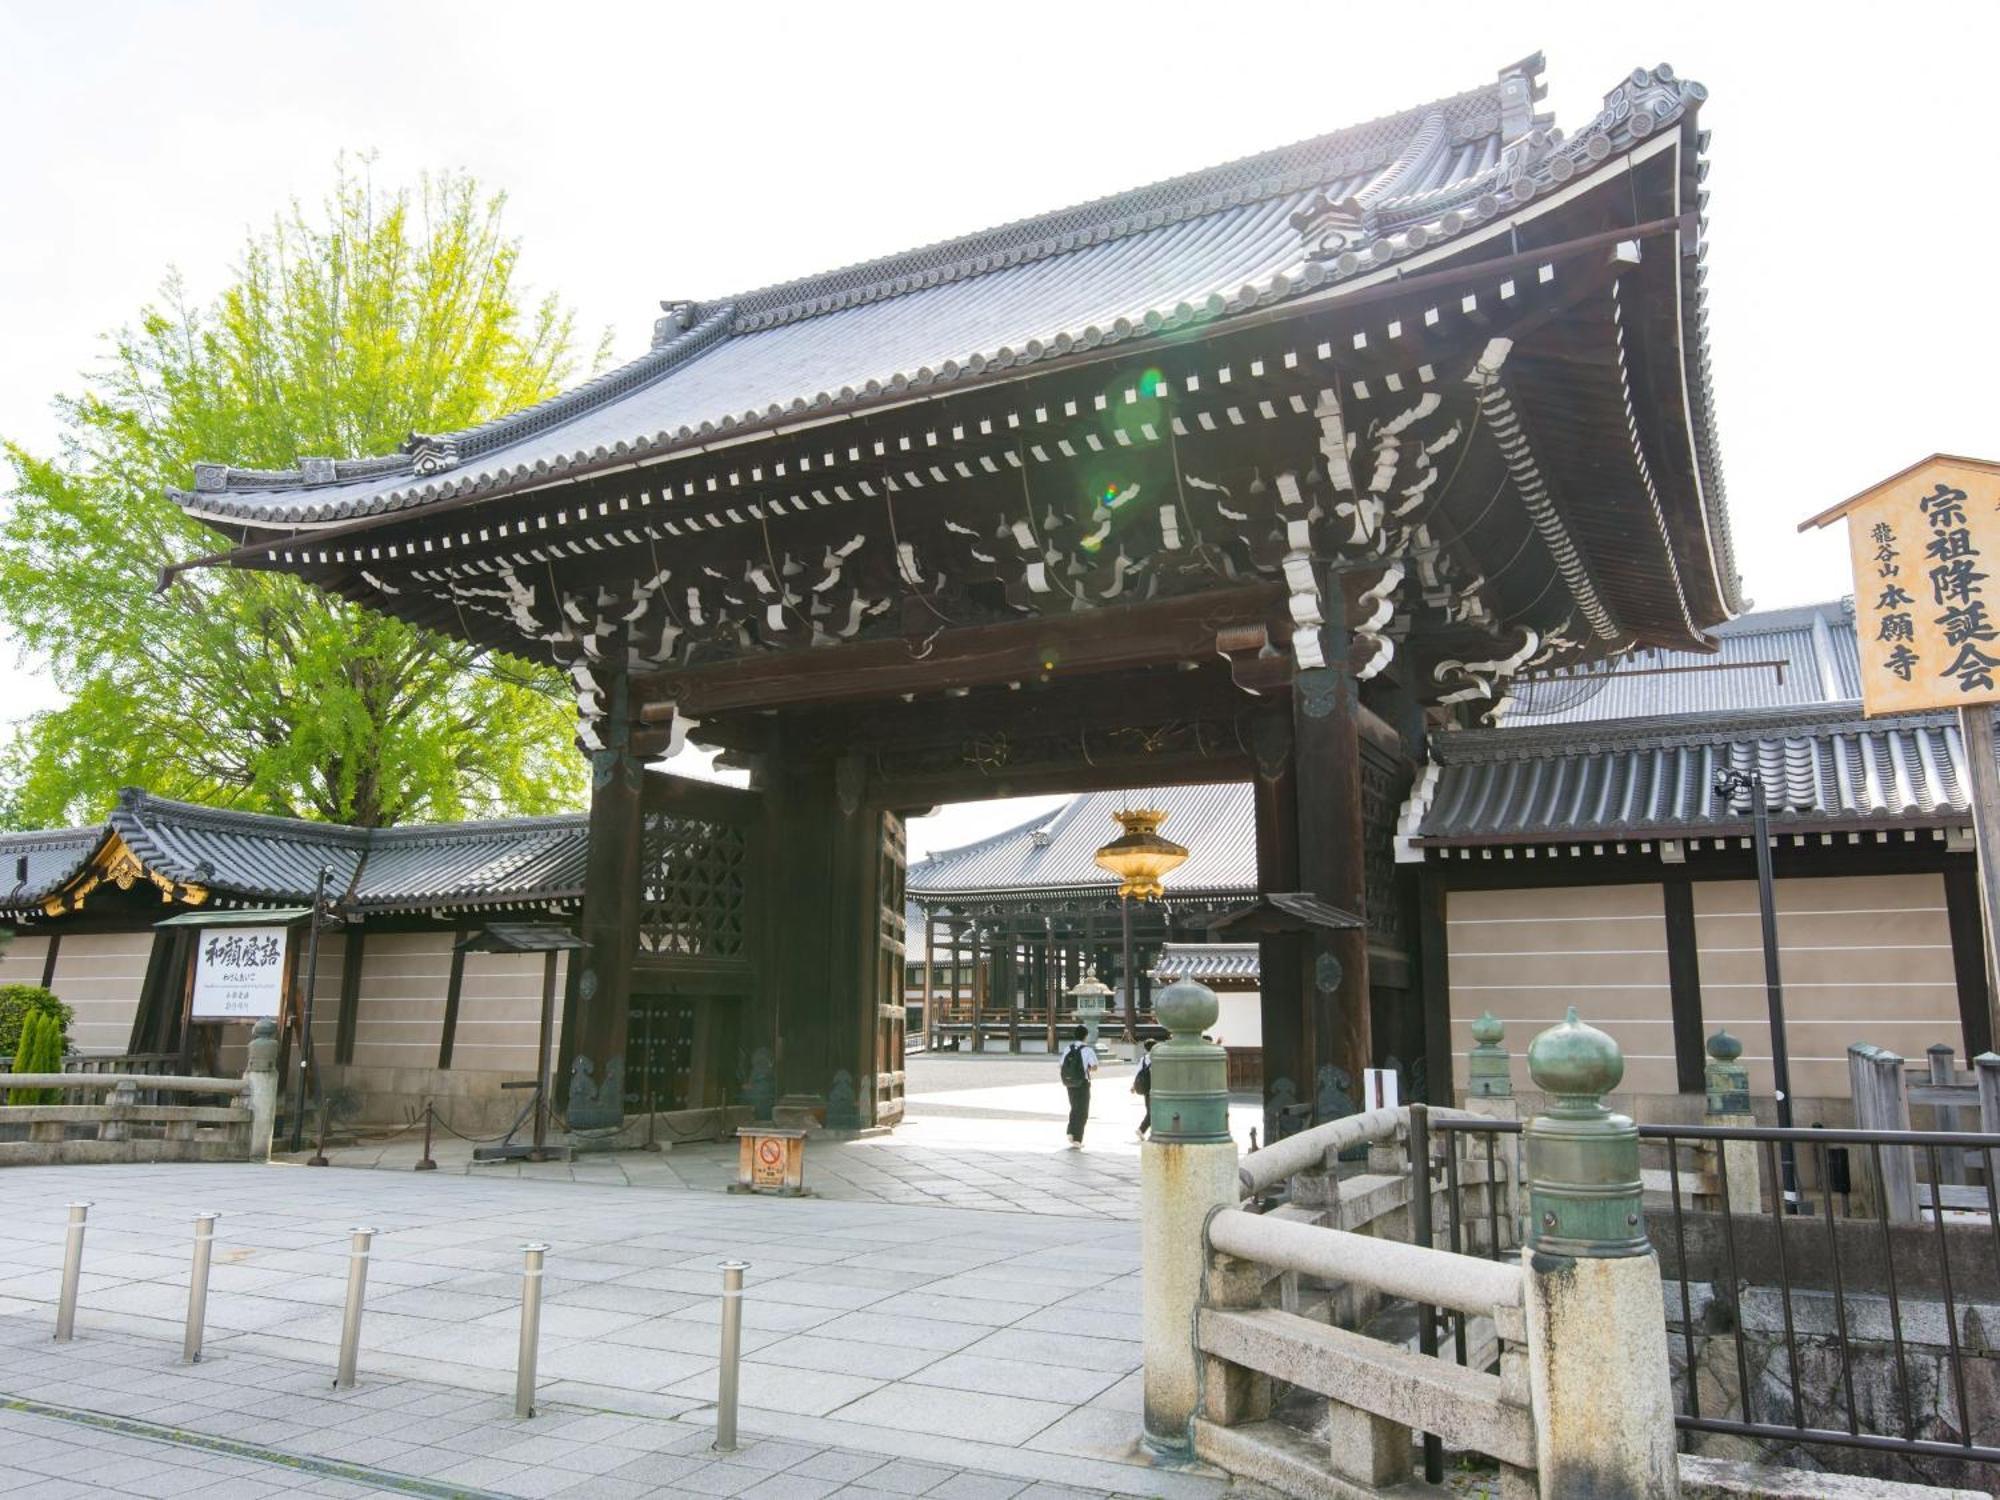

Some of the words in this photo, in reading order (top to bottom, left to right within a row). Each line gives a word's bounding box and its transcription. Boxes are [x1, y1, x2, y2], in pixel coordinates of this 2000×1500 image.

[1919, 484, 2000, 692] 宗祖降誕会
